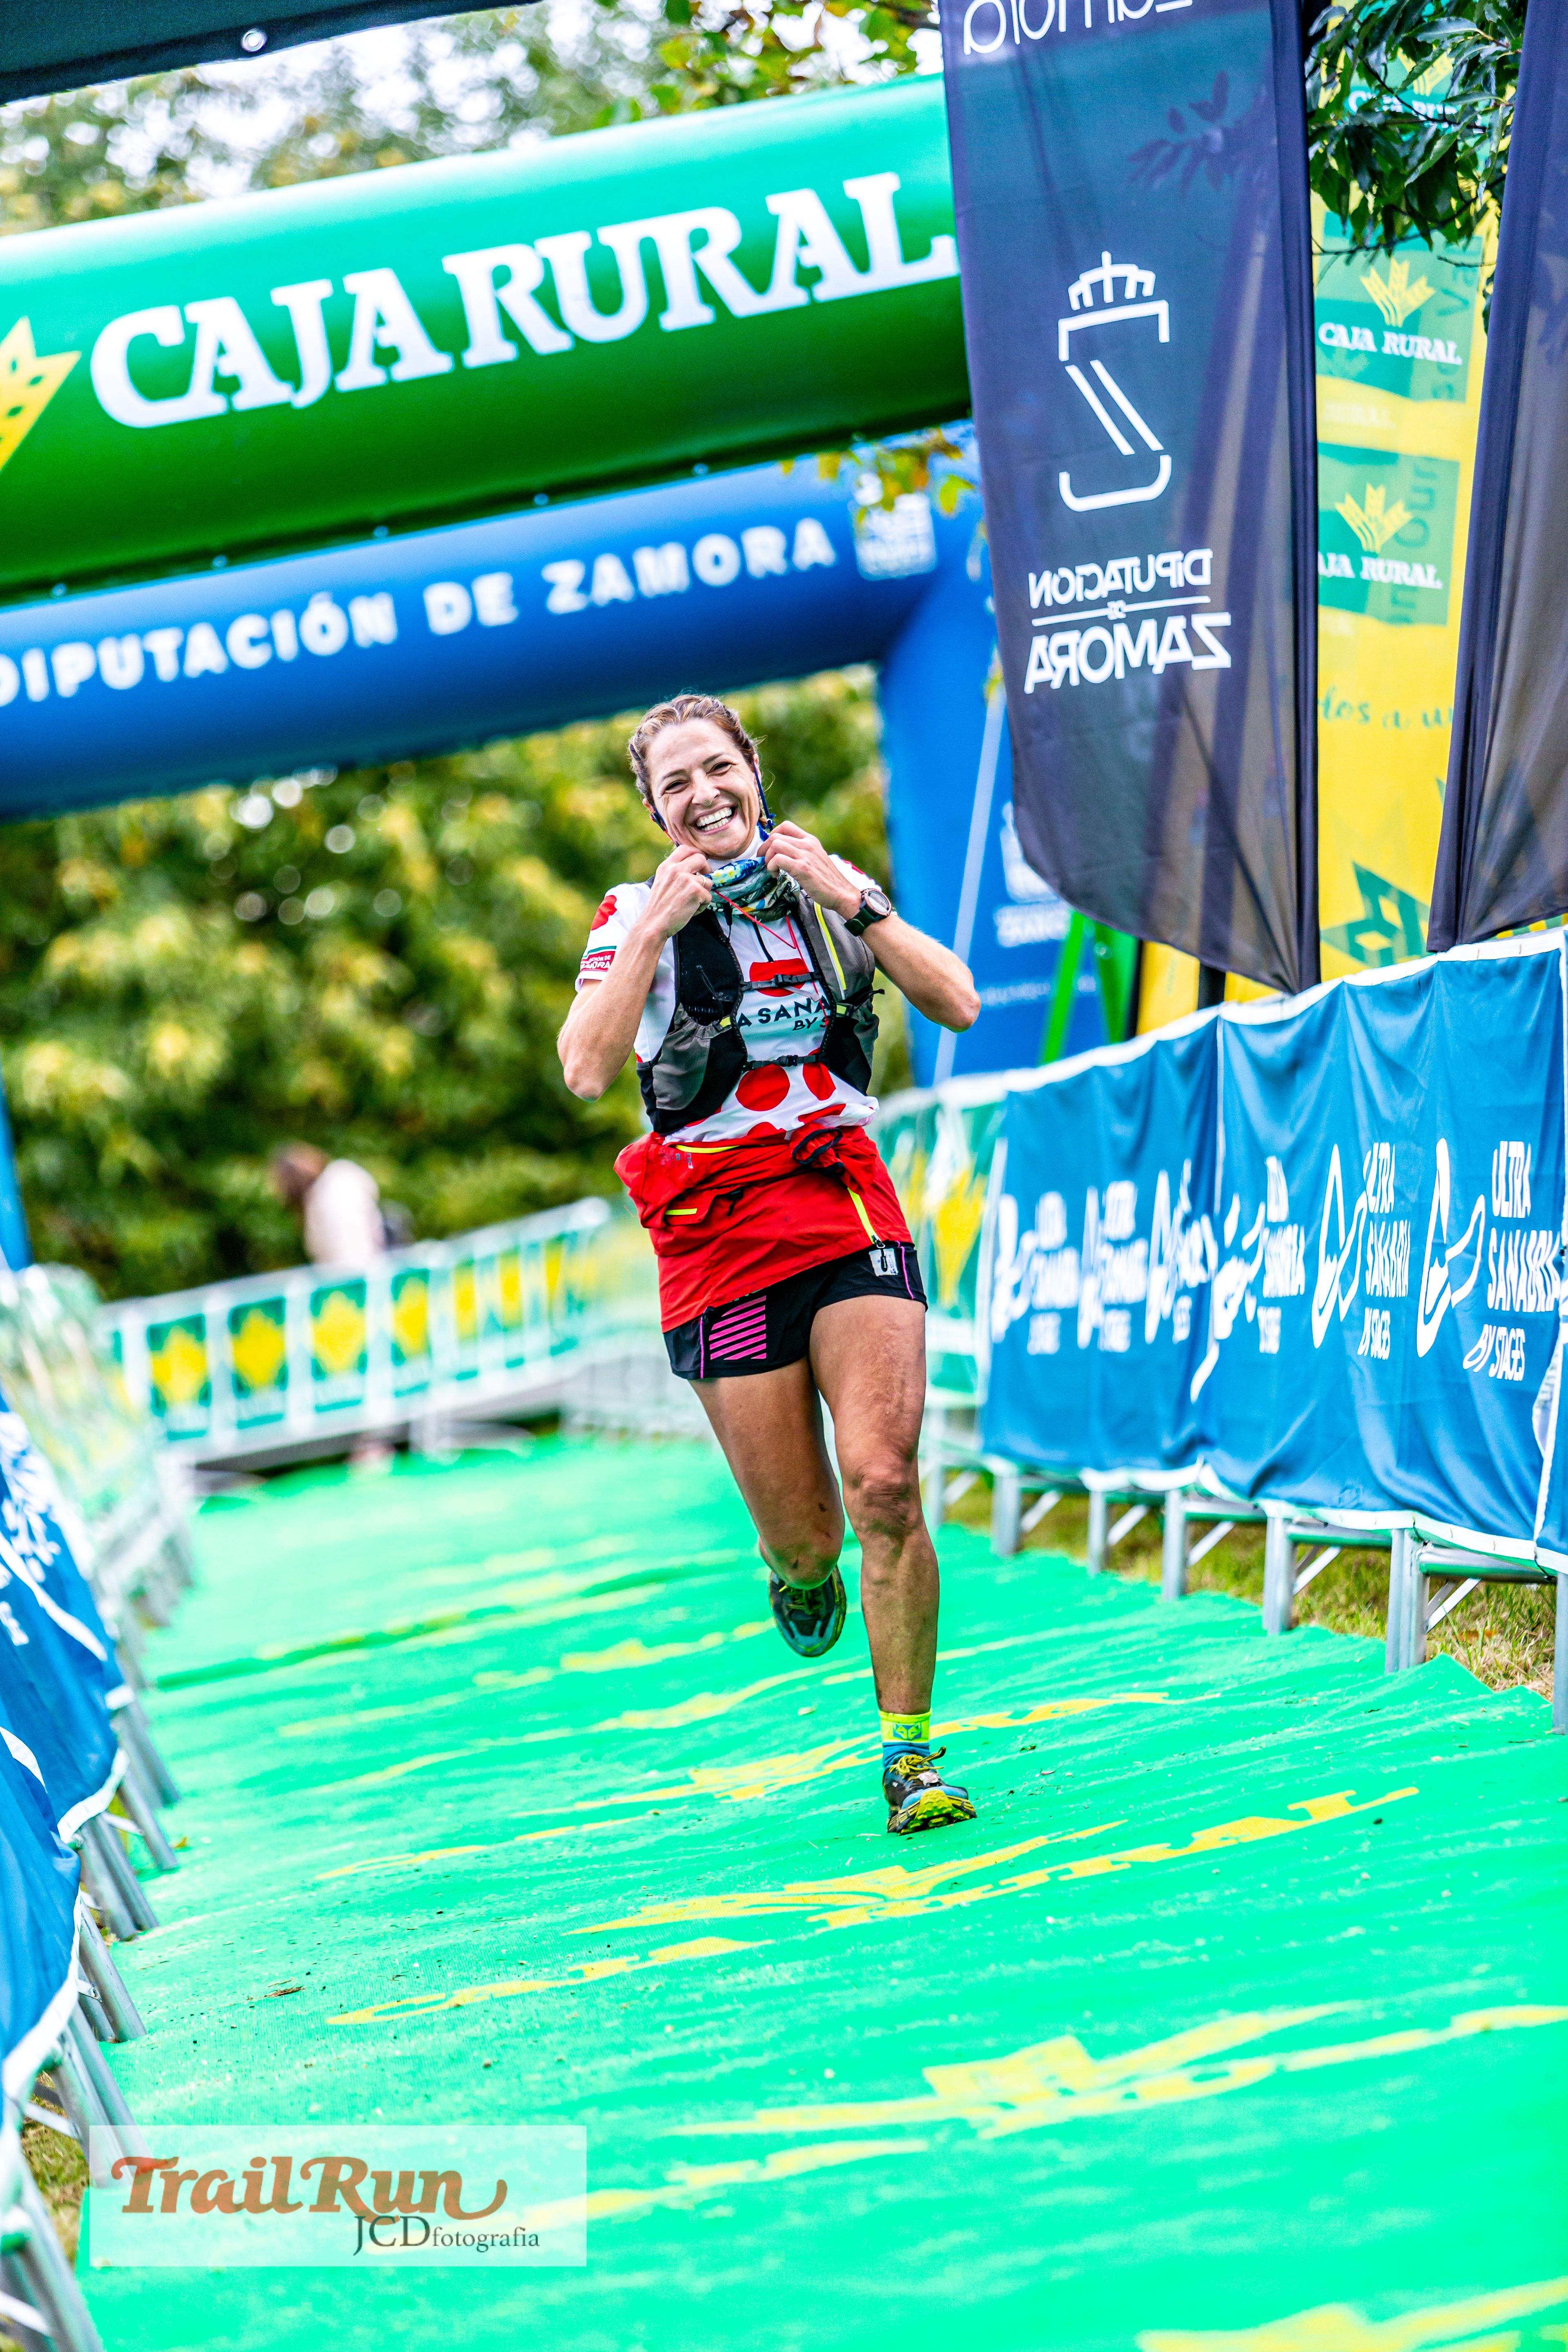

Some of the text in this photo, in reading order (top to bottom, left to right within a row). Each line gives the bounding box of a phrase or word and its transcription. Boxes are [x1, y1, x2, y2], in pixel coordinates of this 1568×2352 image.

[441, 172, 960, 369] RURAL
[1318, 322, 1462, 365] CAJA RURAL
[422, 572, 519, 637] DE
[541, 519, 835, 615] ZAMORA
[1360, 556, 1443, 589] RURAL
[793, 1017, 818, 1031] BY
[1492, 1141, 1531, 1218] ULTRA
[1487, 1227, 1561, 1312] SANABRIA
[1489, 1326, 1525, 1381] STAGES
